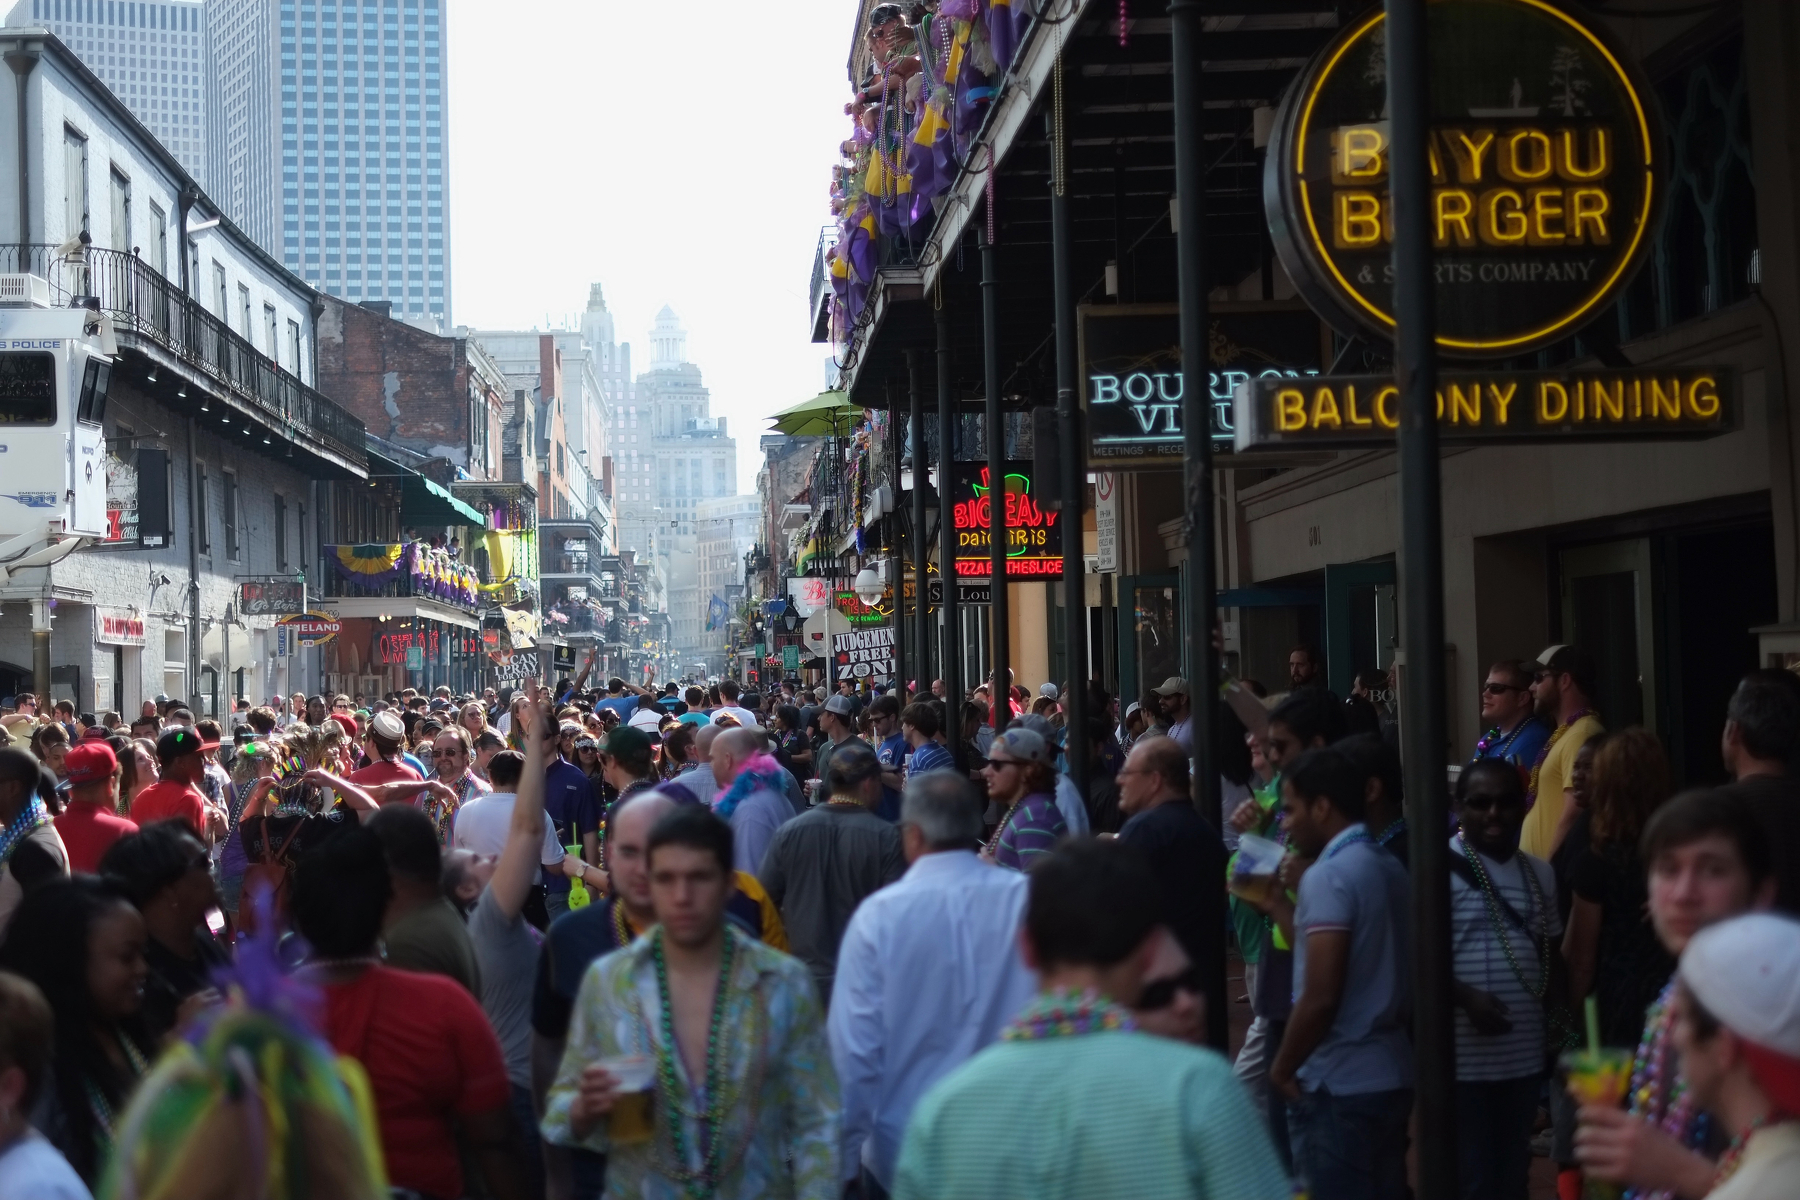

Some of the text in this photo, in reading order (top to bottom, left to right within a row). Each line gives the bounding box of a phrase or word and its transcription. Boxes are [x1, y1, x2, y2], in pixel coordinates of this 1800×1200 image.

[1332, 127, 1612, 184] BYOU
[1333, 189, 1612, 246] BRGER
[1383, 262, 1473, 284] SRTS
[1479, 258, 1596, 282] COMPANY
[12, 341, 61, 349] POLICE
[1274, 376, 1721, 433] BALCNY DINING
[1094, 446, 1144, 456] MEETINGS
[18, 495, 57, 504] 911
[850, 605, 870, 614] ISLE
[834, 627, 895, 652] JUDGEMEN
[510, 652, 538, 665] CAN
[848, 646, 892, 663] FREE
[494, 662, 538, 676] I PRAY
[498, 671, 538, 681] FOR YOU?
